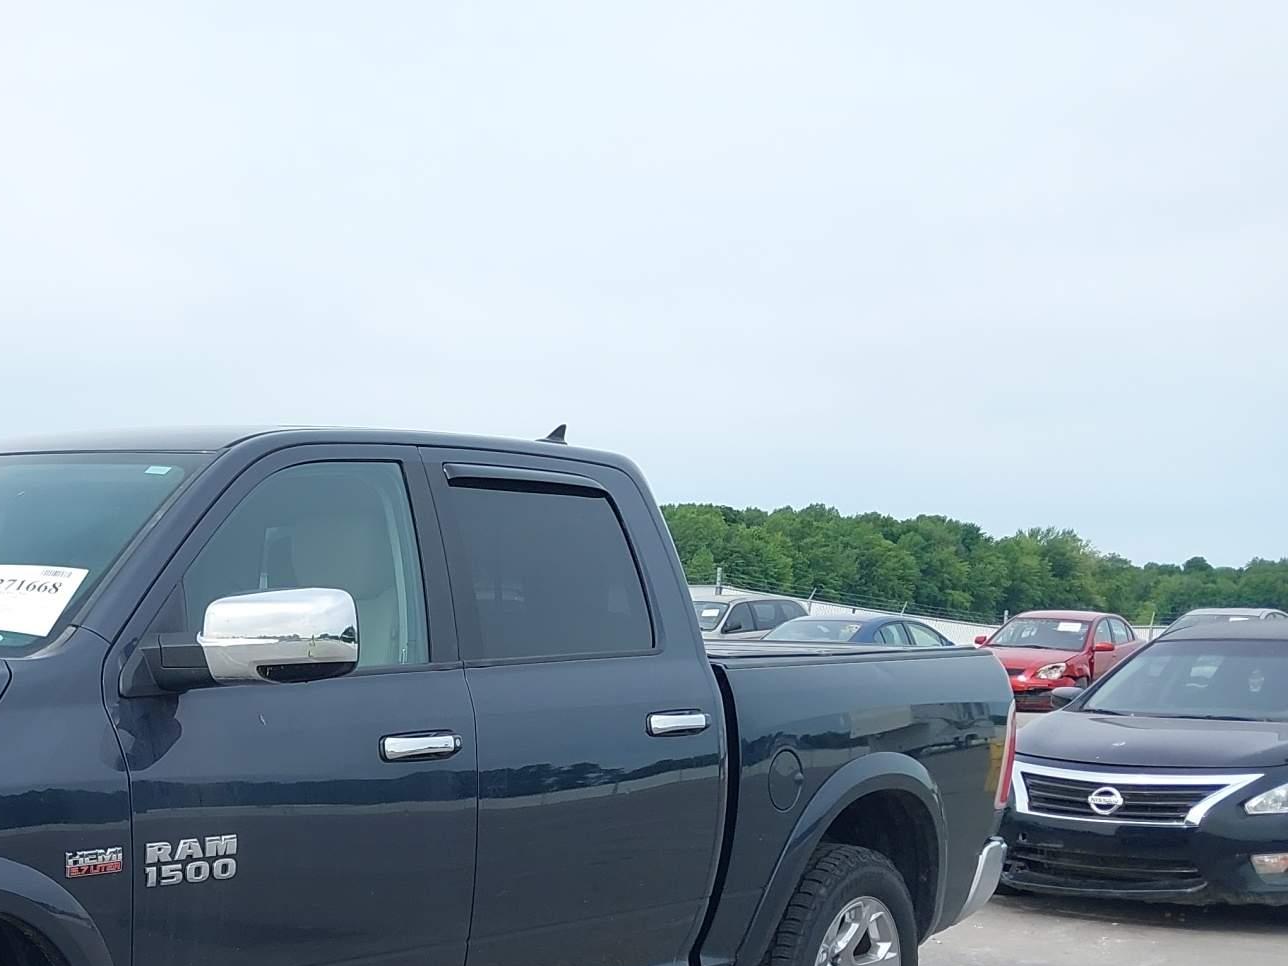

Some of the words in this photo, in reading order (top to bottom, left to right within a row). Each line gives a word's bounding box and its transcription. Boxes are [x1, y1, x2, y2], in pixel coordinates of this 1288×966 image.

[65, 847, 123, 867] HEMI
[146, 834, 237, 864] RAM
[146, 858, 236, 887] 1500
